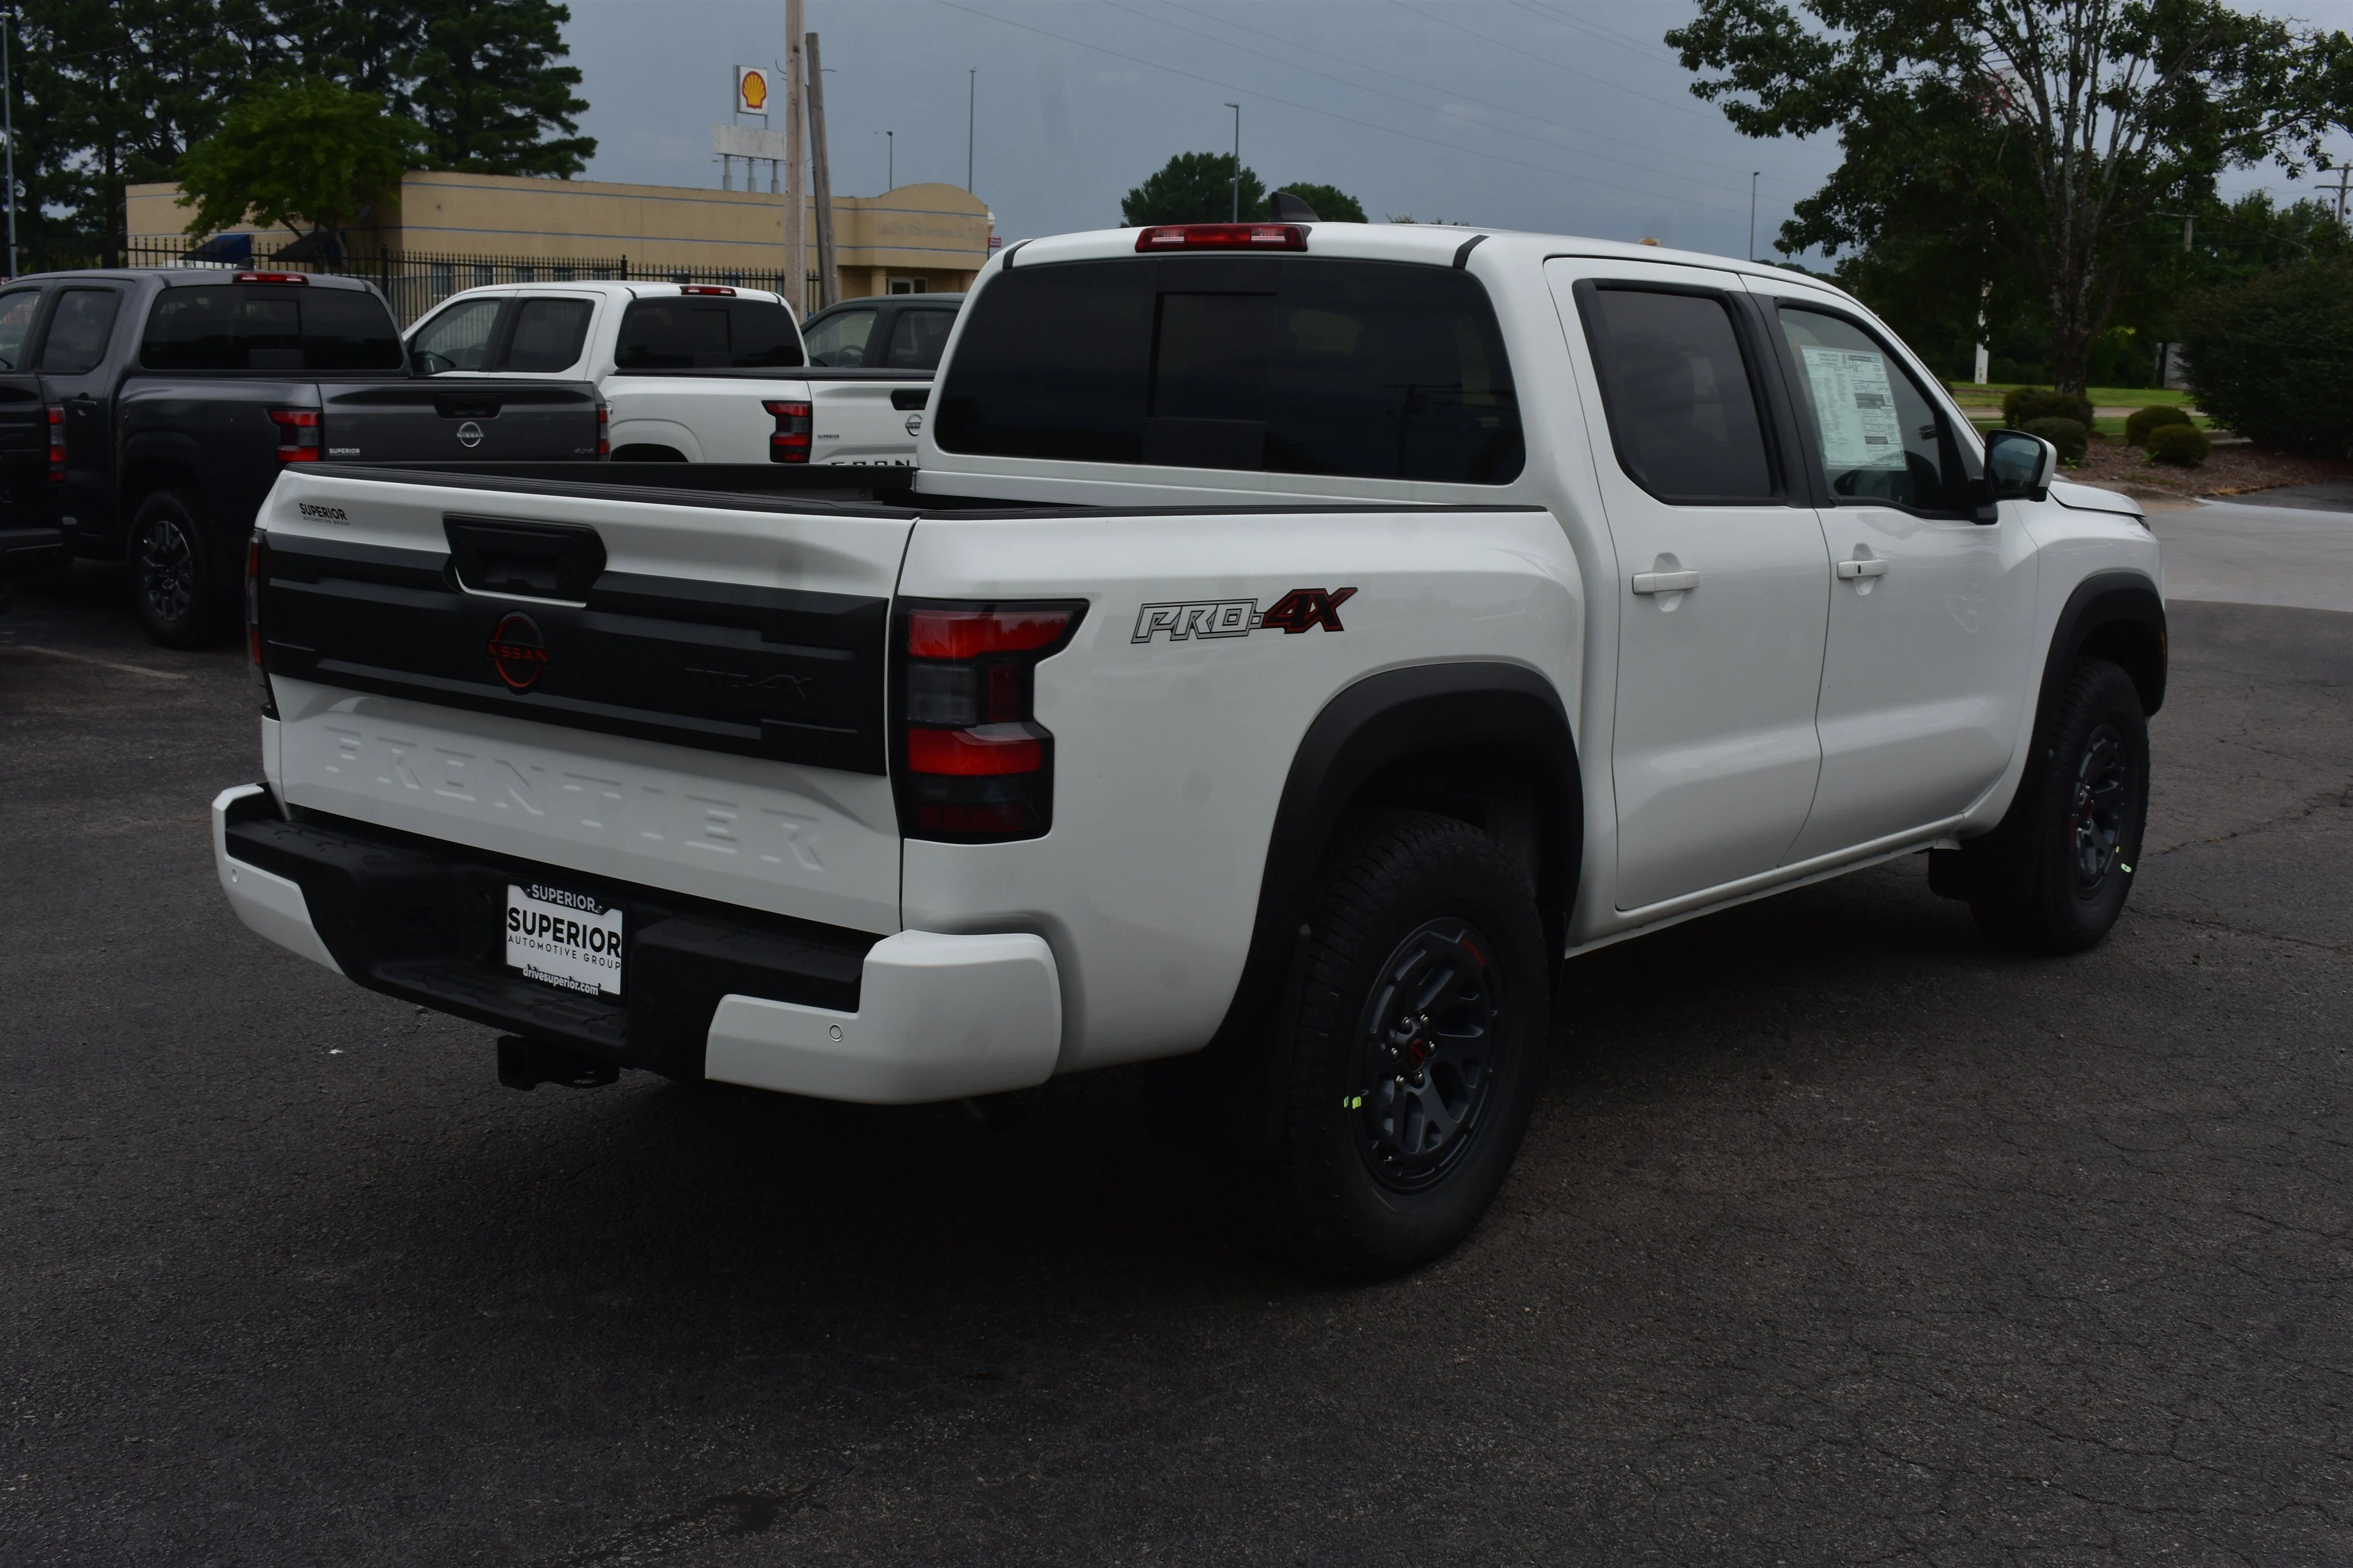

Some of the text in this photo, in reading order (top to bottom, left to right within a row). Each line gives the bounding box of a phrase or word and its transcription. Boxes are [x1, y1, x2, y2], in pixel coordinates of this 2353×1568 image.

[299, 503, 348, 520] SUPERIOR
[1131, 587, 1358, 644] PRO-4X
[489, 642, 549, 663] NISSAN
[508, 907, 621, 958] SUPERIOR
[508, 934, 620, 971] AUTOMOTIVE GROUP
[523, 967, 599, 995] drivesuperior.com
